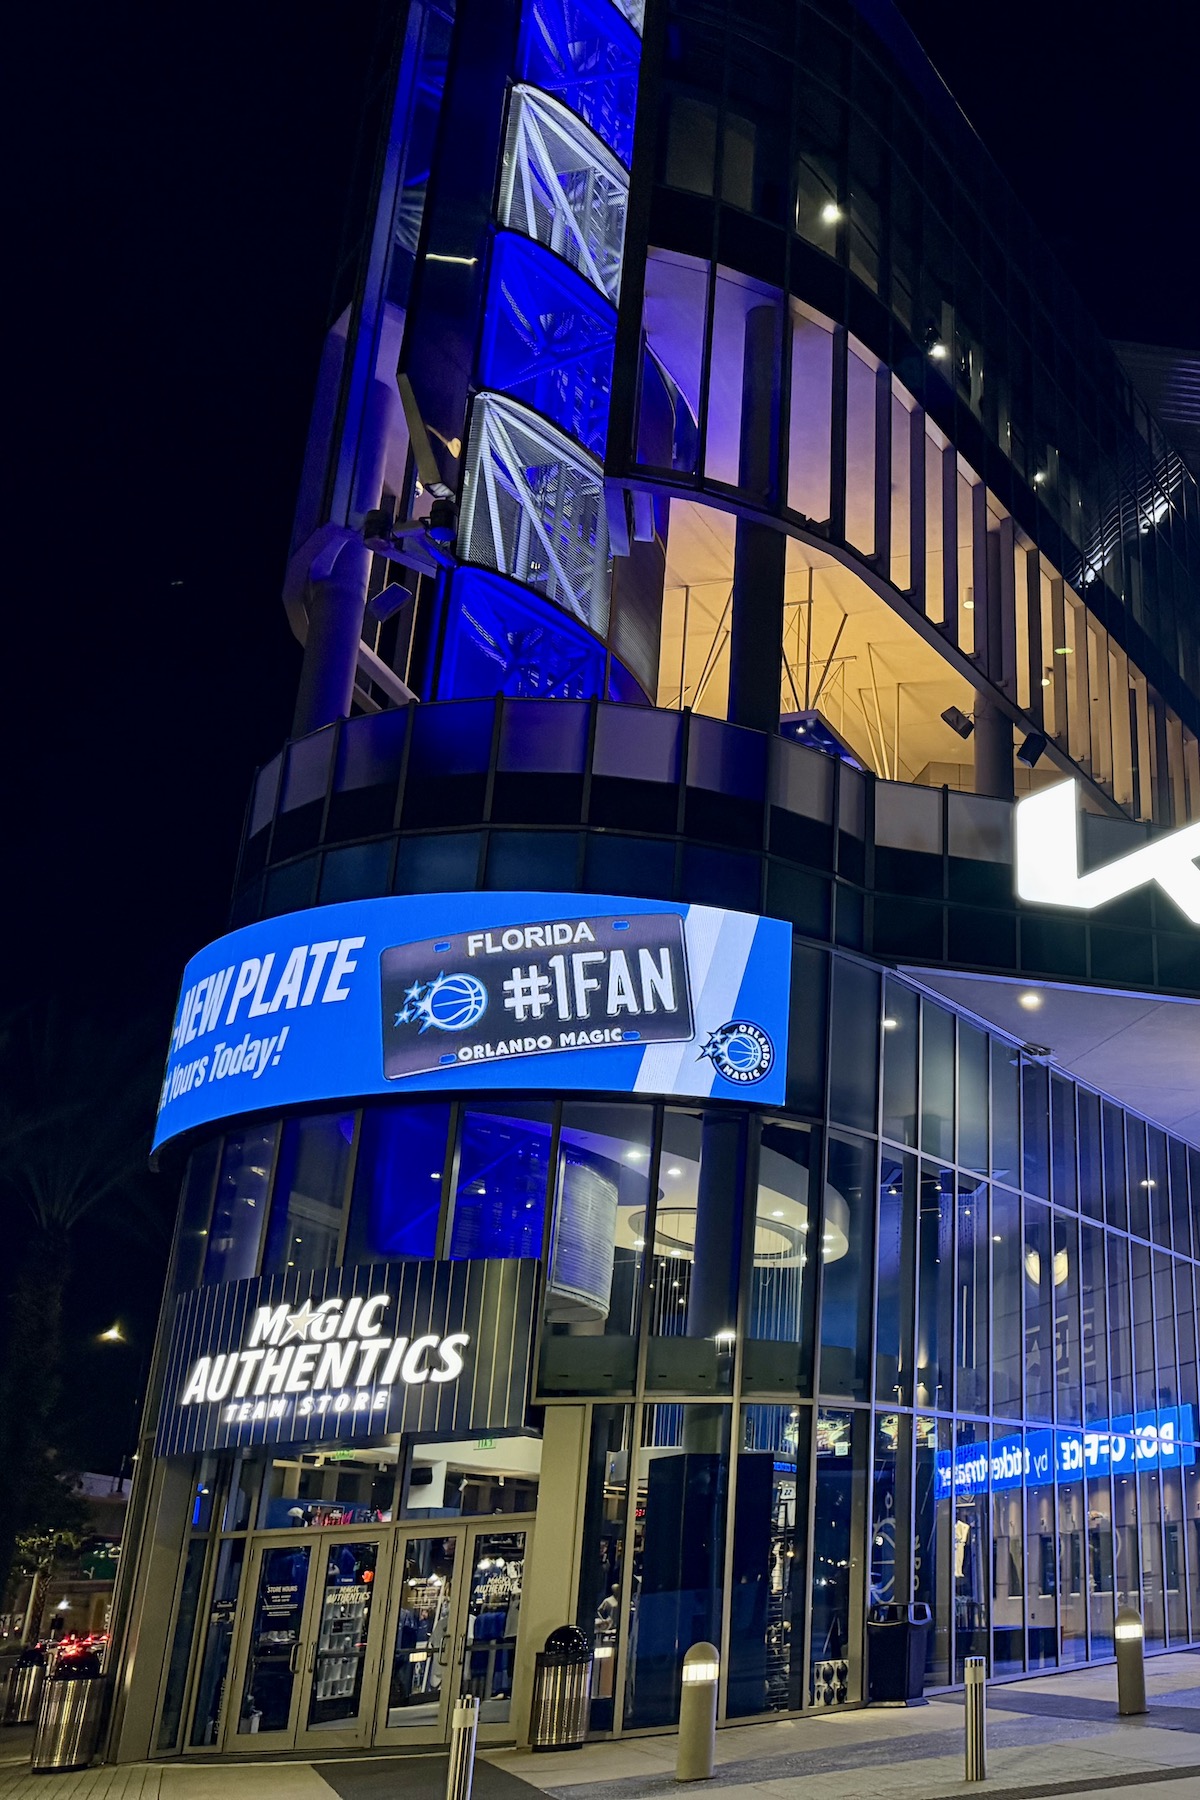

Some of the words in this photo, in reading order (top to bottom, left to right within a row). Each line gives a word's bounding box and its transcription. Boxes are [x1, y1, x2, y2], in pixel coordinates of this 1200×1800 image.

[467, 921, 595, 956] FLORIDA
[225, 936, 366, 1025] PLATE
[503, 947, 678, 1022] #1FAN
[458, 1032, 552, 1061] ORLANDO
[560, 1027, 623, 1047] MAGIC
[739, 1024, 770, 1068] ORLANDO
[168, 1055, 209, 1103] Yours
[208, 1026, 290, 1083] Today!
[723, 1065, 760, 1081] MAGIC
[182, 1333, 470, 1405] AUTHENTICS
[224, 1401, 289, 1422] TEAM
[300, 1391, 388, 1415] STORE
[326, 1592, 371, 1604] AUTHENTICS
